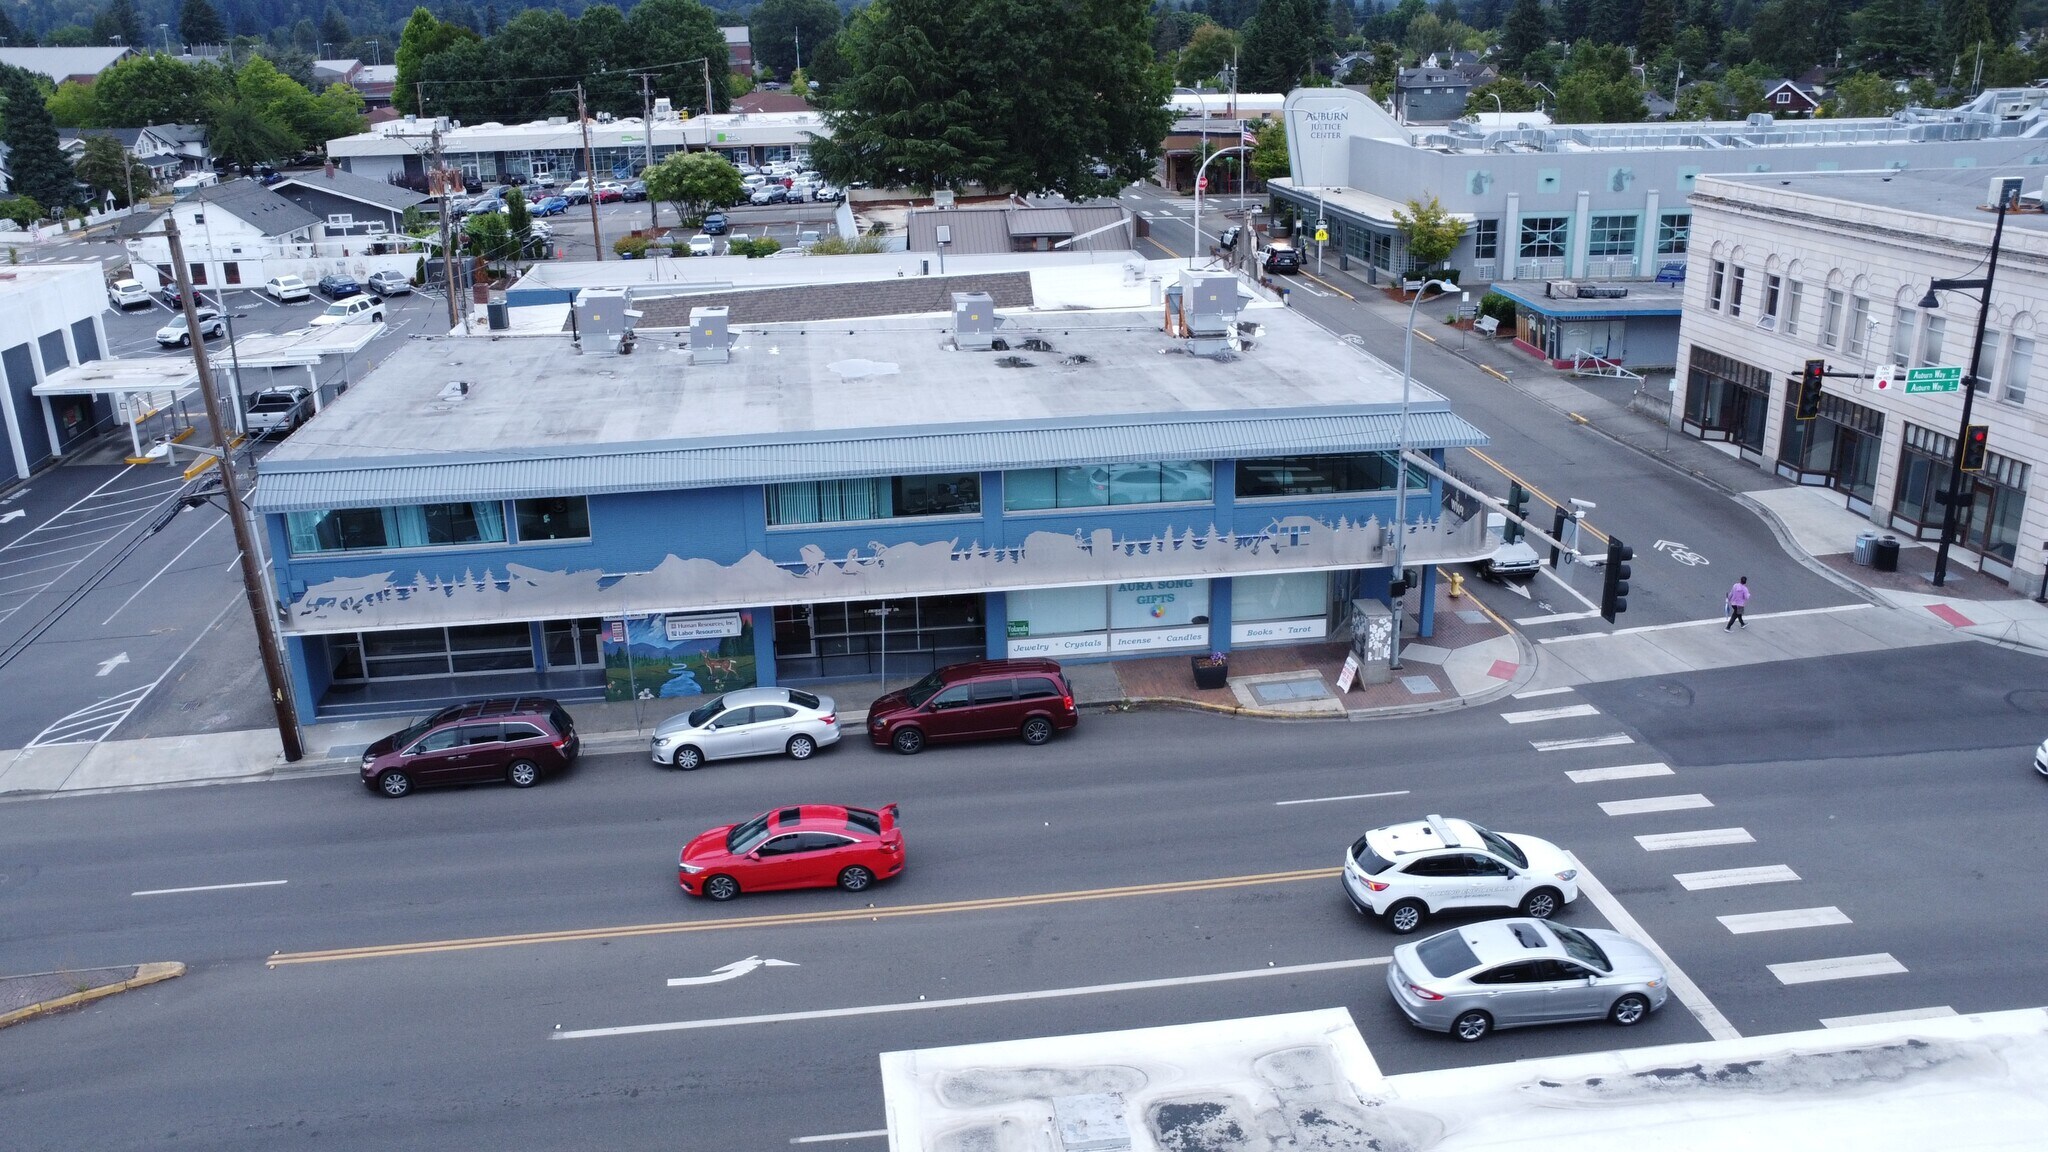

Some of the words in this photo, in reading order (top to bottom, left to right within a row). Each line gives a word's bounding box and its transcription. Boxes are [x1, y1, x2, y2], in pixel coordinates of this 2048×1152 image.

[1305, 112, 1348, 121] AUBURN
[1913, 371, 1933, 380] Auburn
[1934, 369, 1946, 380] Way
[1910, 383, 1931, 392] Auburn
[1932, 382, 1944, 392] Way
[1118, 582, 1153, 592] AURA
[1158, 579, 1193, 590] SONG
[1136, 593, 1175, 605] GIFTS
[1247, 628, 1273, 637] Books
[1287, 626, 1312, 634] Tarot
[1117, 638, 1152, 646] Incense
[1166, 633, 1202, 642] Candles
[1013, 643, 1049, 652] Jewelry
[1064, 639, 1102, 649] Crystals
